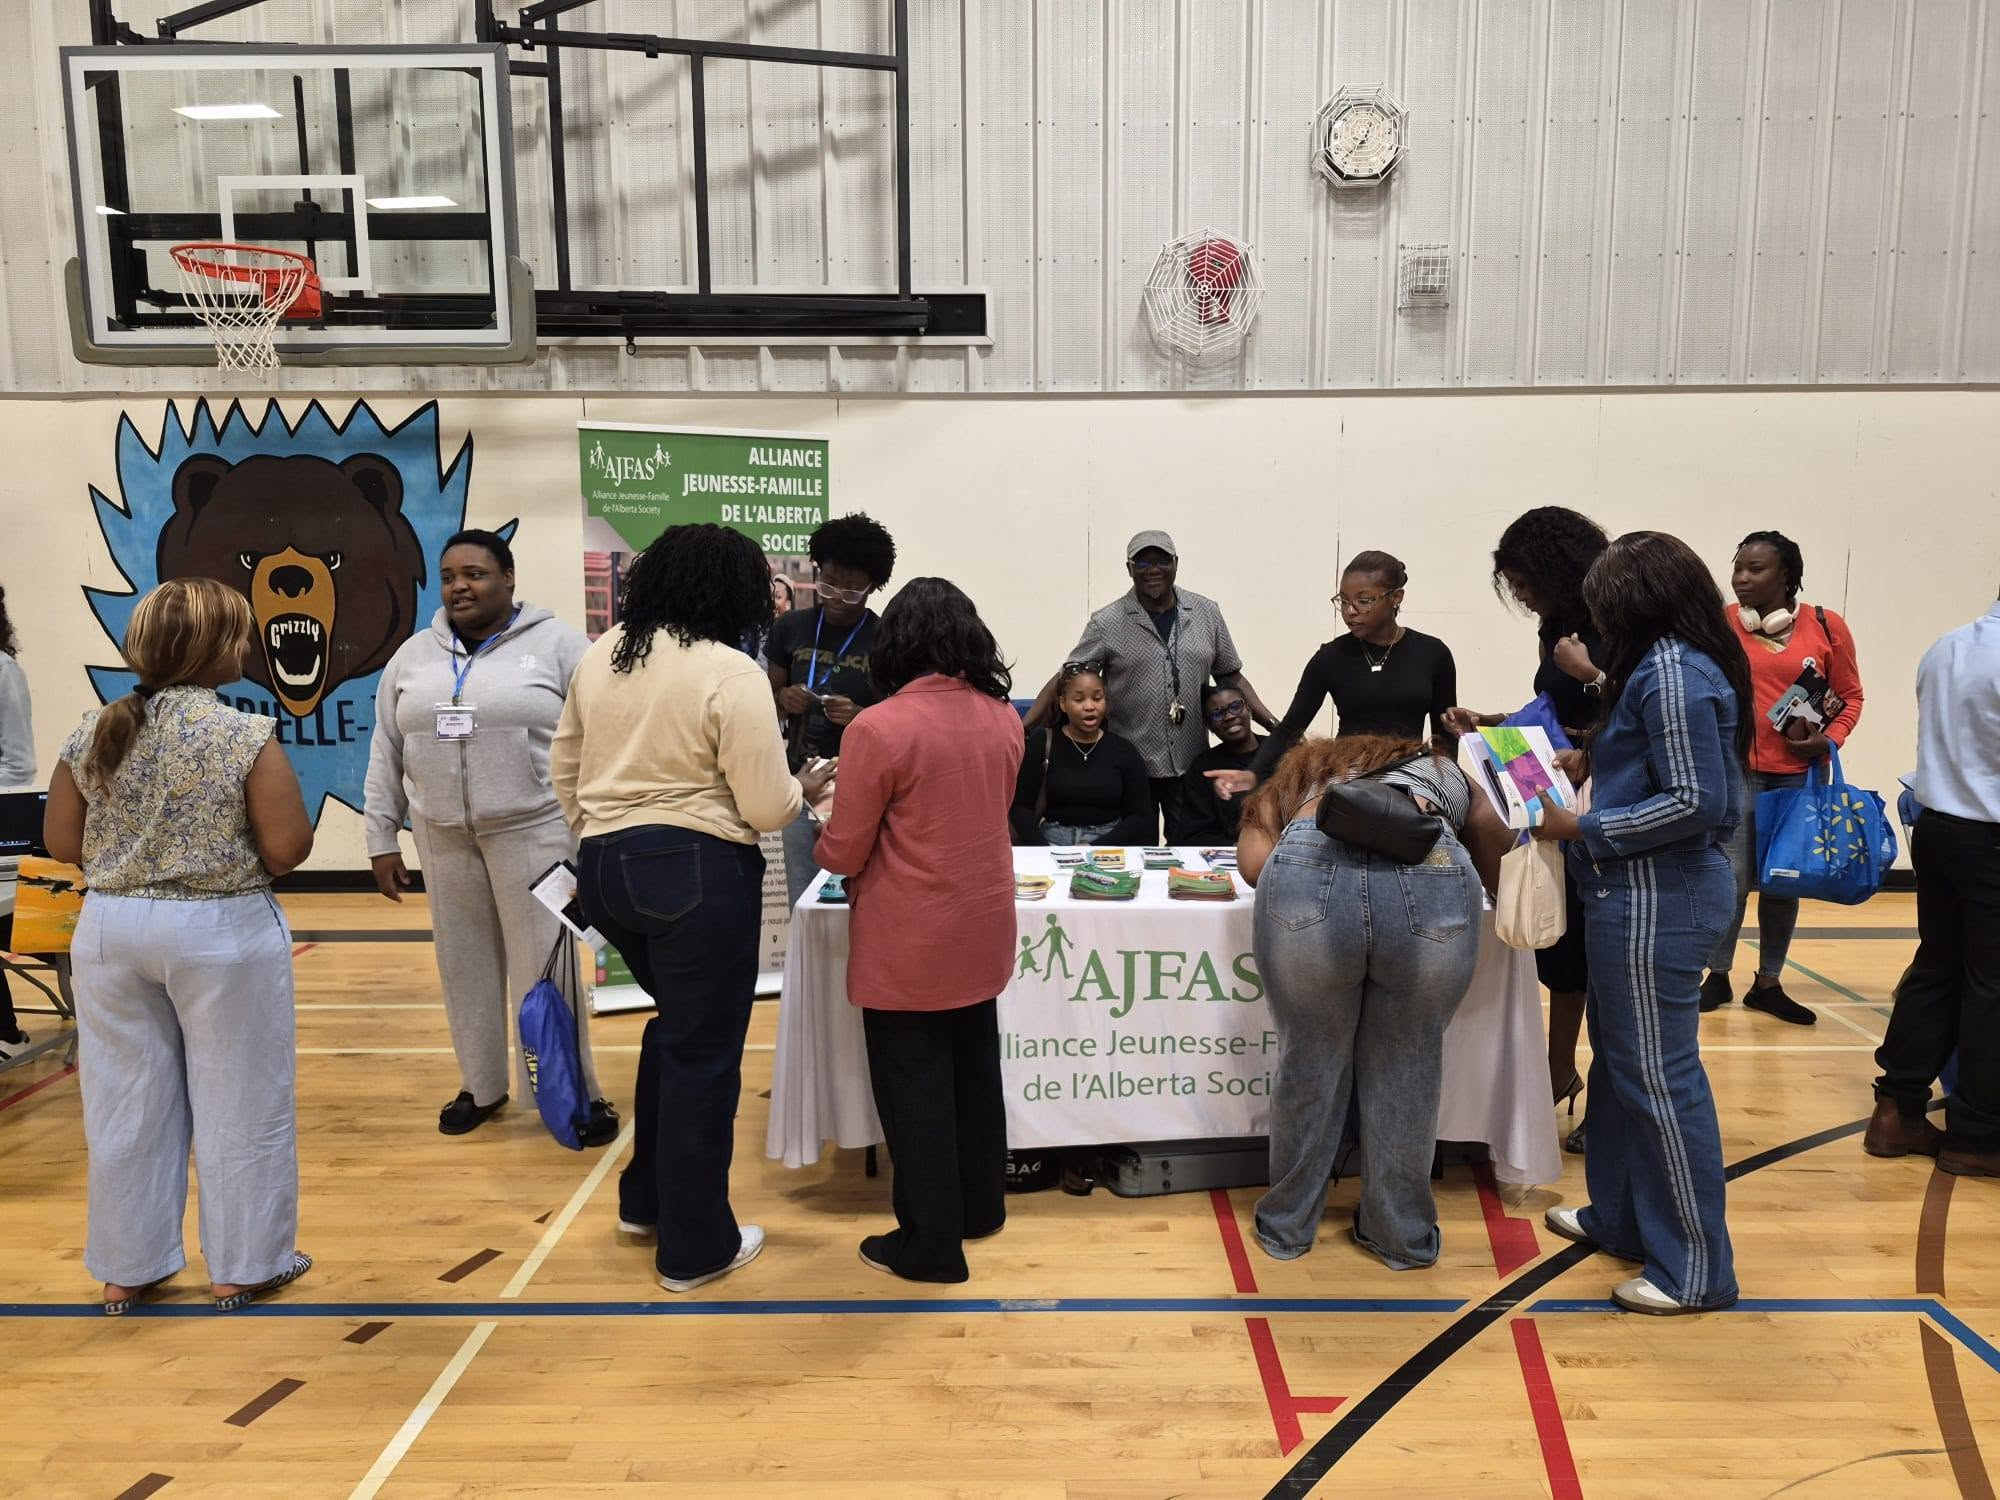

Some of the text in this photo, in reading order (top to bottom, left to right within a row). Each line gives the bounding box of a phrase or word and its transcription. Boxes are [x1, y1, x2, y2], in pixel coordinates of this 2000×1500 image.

[748, 447, 822, 468] ALLIANCE
[603, 456, 655, 487] AJFAS
[592, 490, 670, 502] Alliance Jeunesse-Famille
[682, 473, 822, 497] JEUNESSE-FAMILLE
[602, 503, 661, 516] de l'Alberta Society
[721, 504, 822, 525] DE L'ALBERTA
[270, 618, 320, 650] Grizzly
[1068, 949, 1265, 1019] AJFAS
[1106, 1029, 1278, 1056] Jeunesse-F
[1023, 1070, 1271, 1102] de l'Alberta Soci
